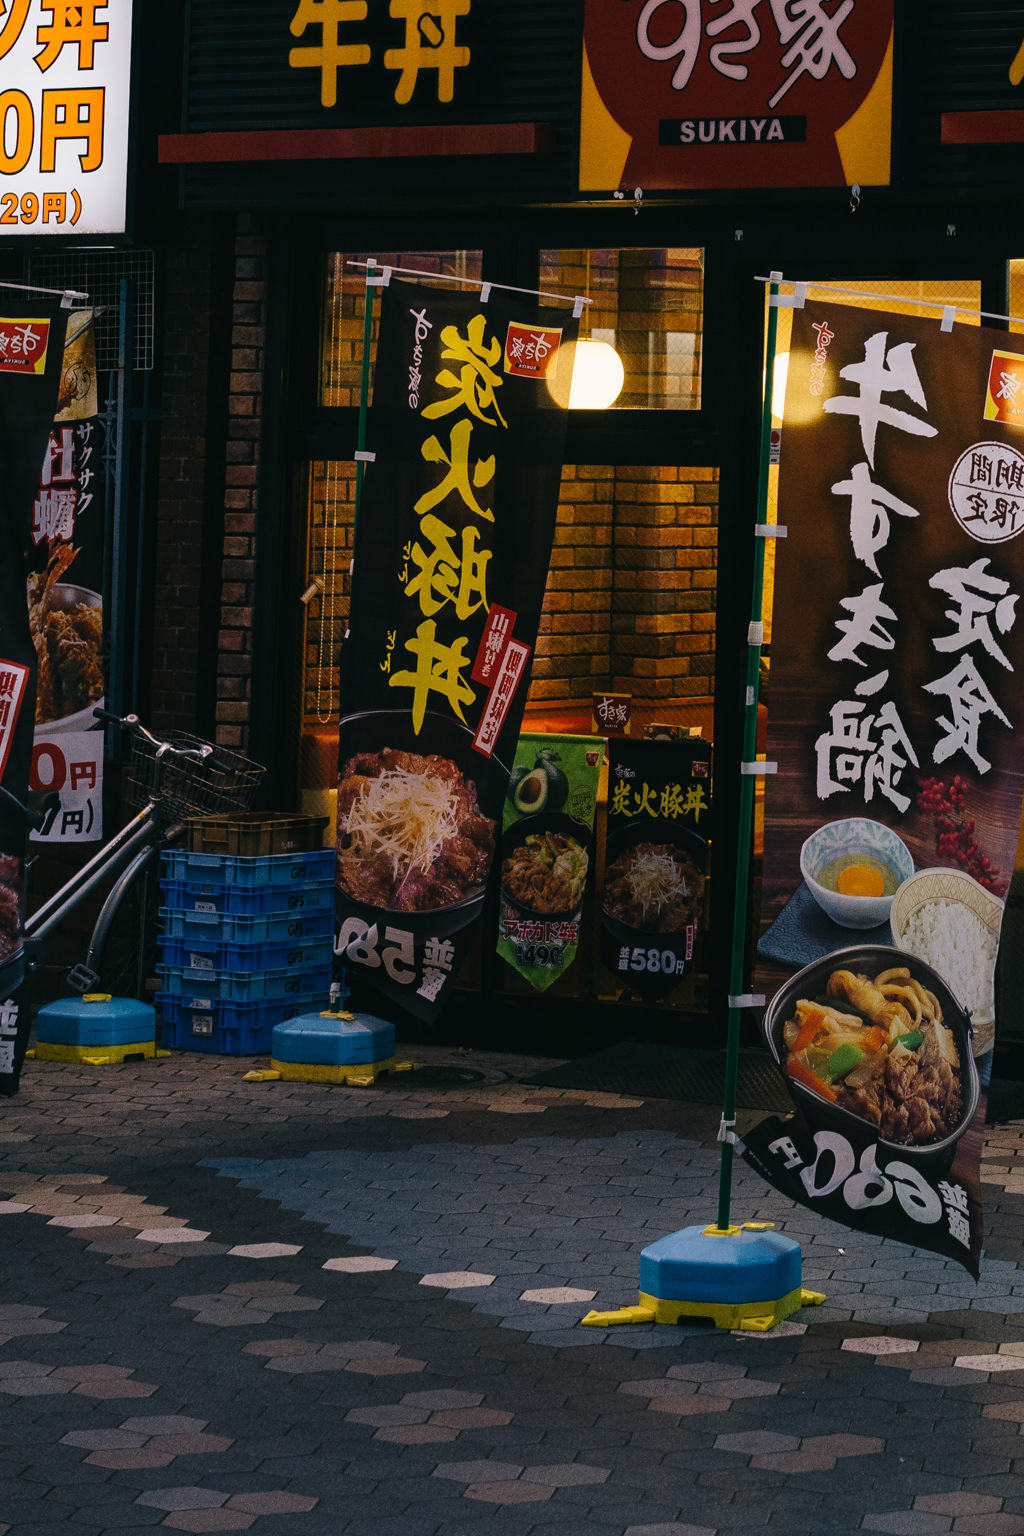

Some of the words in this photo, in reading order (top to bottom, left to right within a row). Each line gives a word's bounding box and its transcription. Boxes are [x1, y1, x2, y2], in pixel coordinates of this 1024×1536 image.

[678, 118, 785, 145] SUKIYA
[76, 421, 95, 516] サクサク
[597, 696, 628, 724] すき家
[608, 779, 709, 825] 炭火豚丼
[290, 866, 307, 880] GFS
[287, 895, 305, 909] GFS
[287, 923, 304, 937] GFS
[287, 951, 303, 965] GFS
[630, 946, 685, 975] 580円
